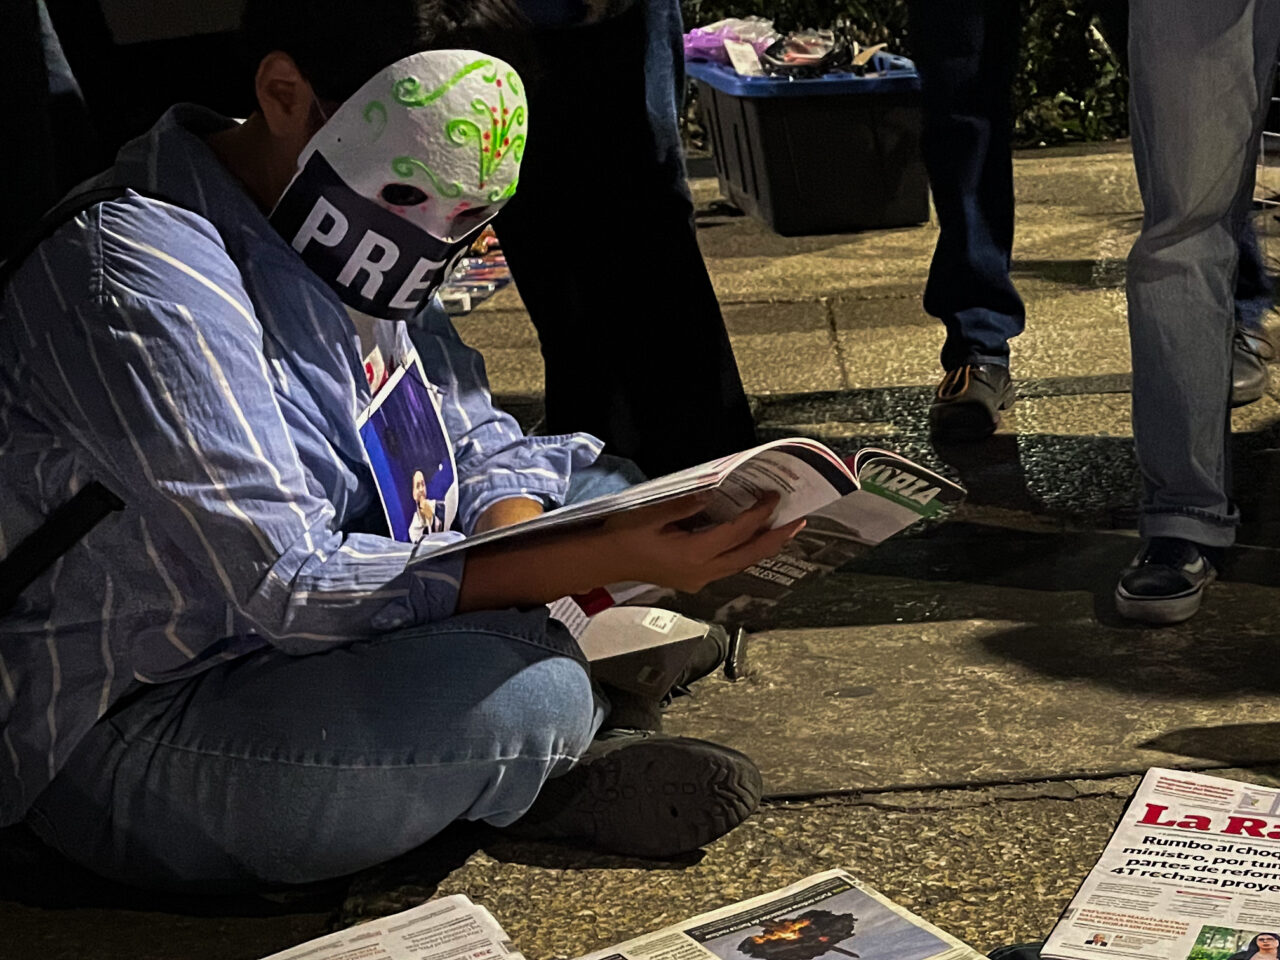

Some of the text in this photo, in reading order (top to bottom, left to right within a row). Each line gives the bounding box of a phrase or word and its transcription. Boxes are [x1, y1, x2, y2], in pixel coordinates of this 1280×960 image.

[291, 196, 447, 309] PRE
[1137, 803, 1212, 831] La
[1142, 835, 1213, 851] Rumbo
[1215, 844, 1234, 853] al
[1122, 847, 1209, 863] ministro,
[1211, 857, 1248, 866] por
[1125, 859, 1190, 870] partes
[1193, 865, 1219, 874] de
[1110, 867, 1140, 876] 4T
[1140, 870, 1219, 885] rechaza
